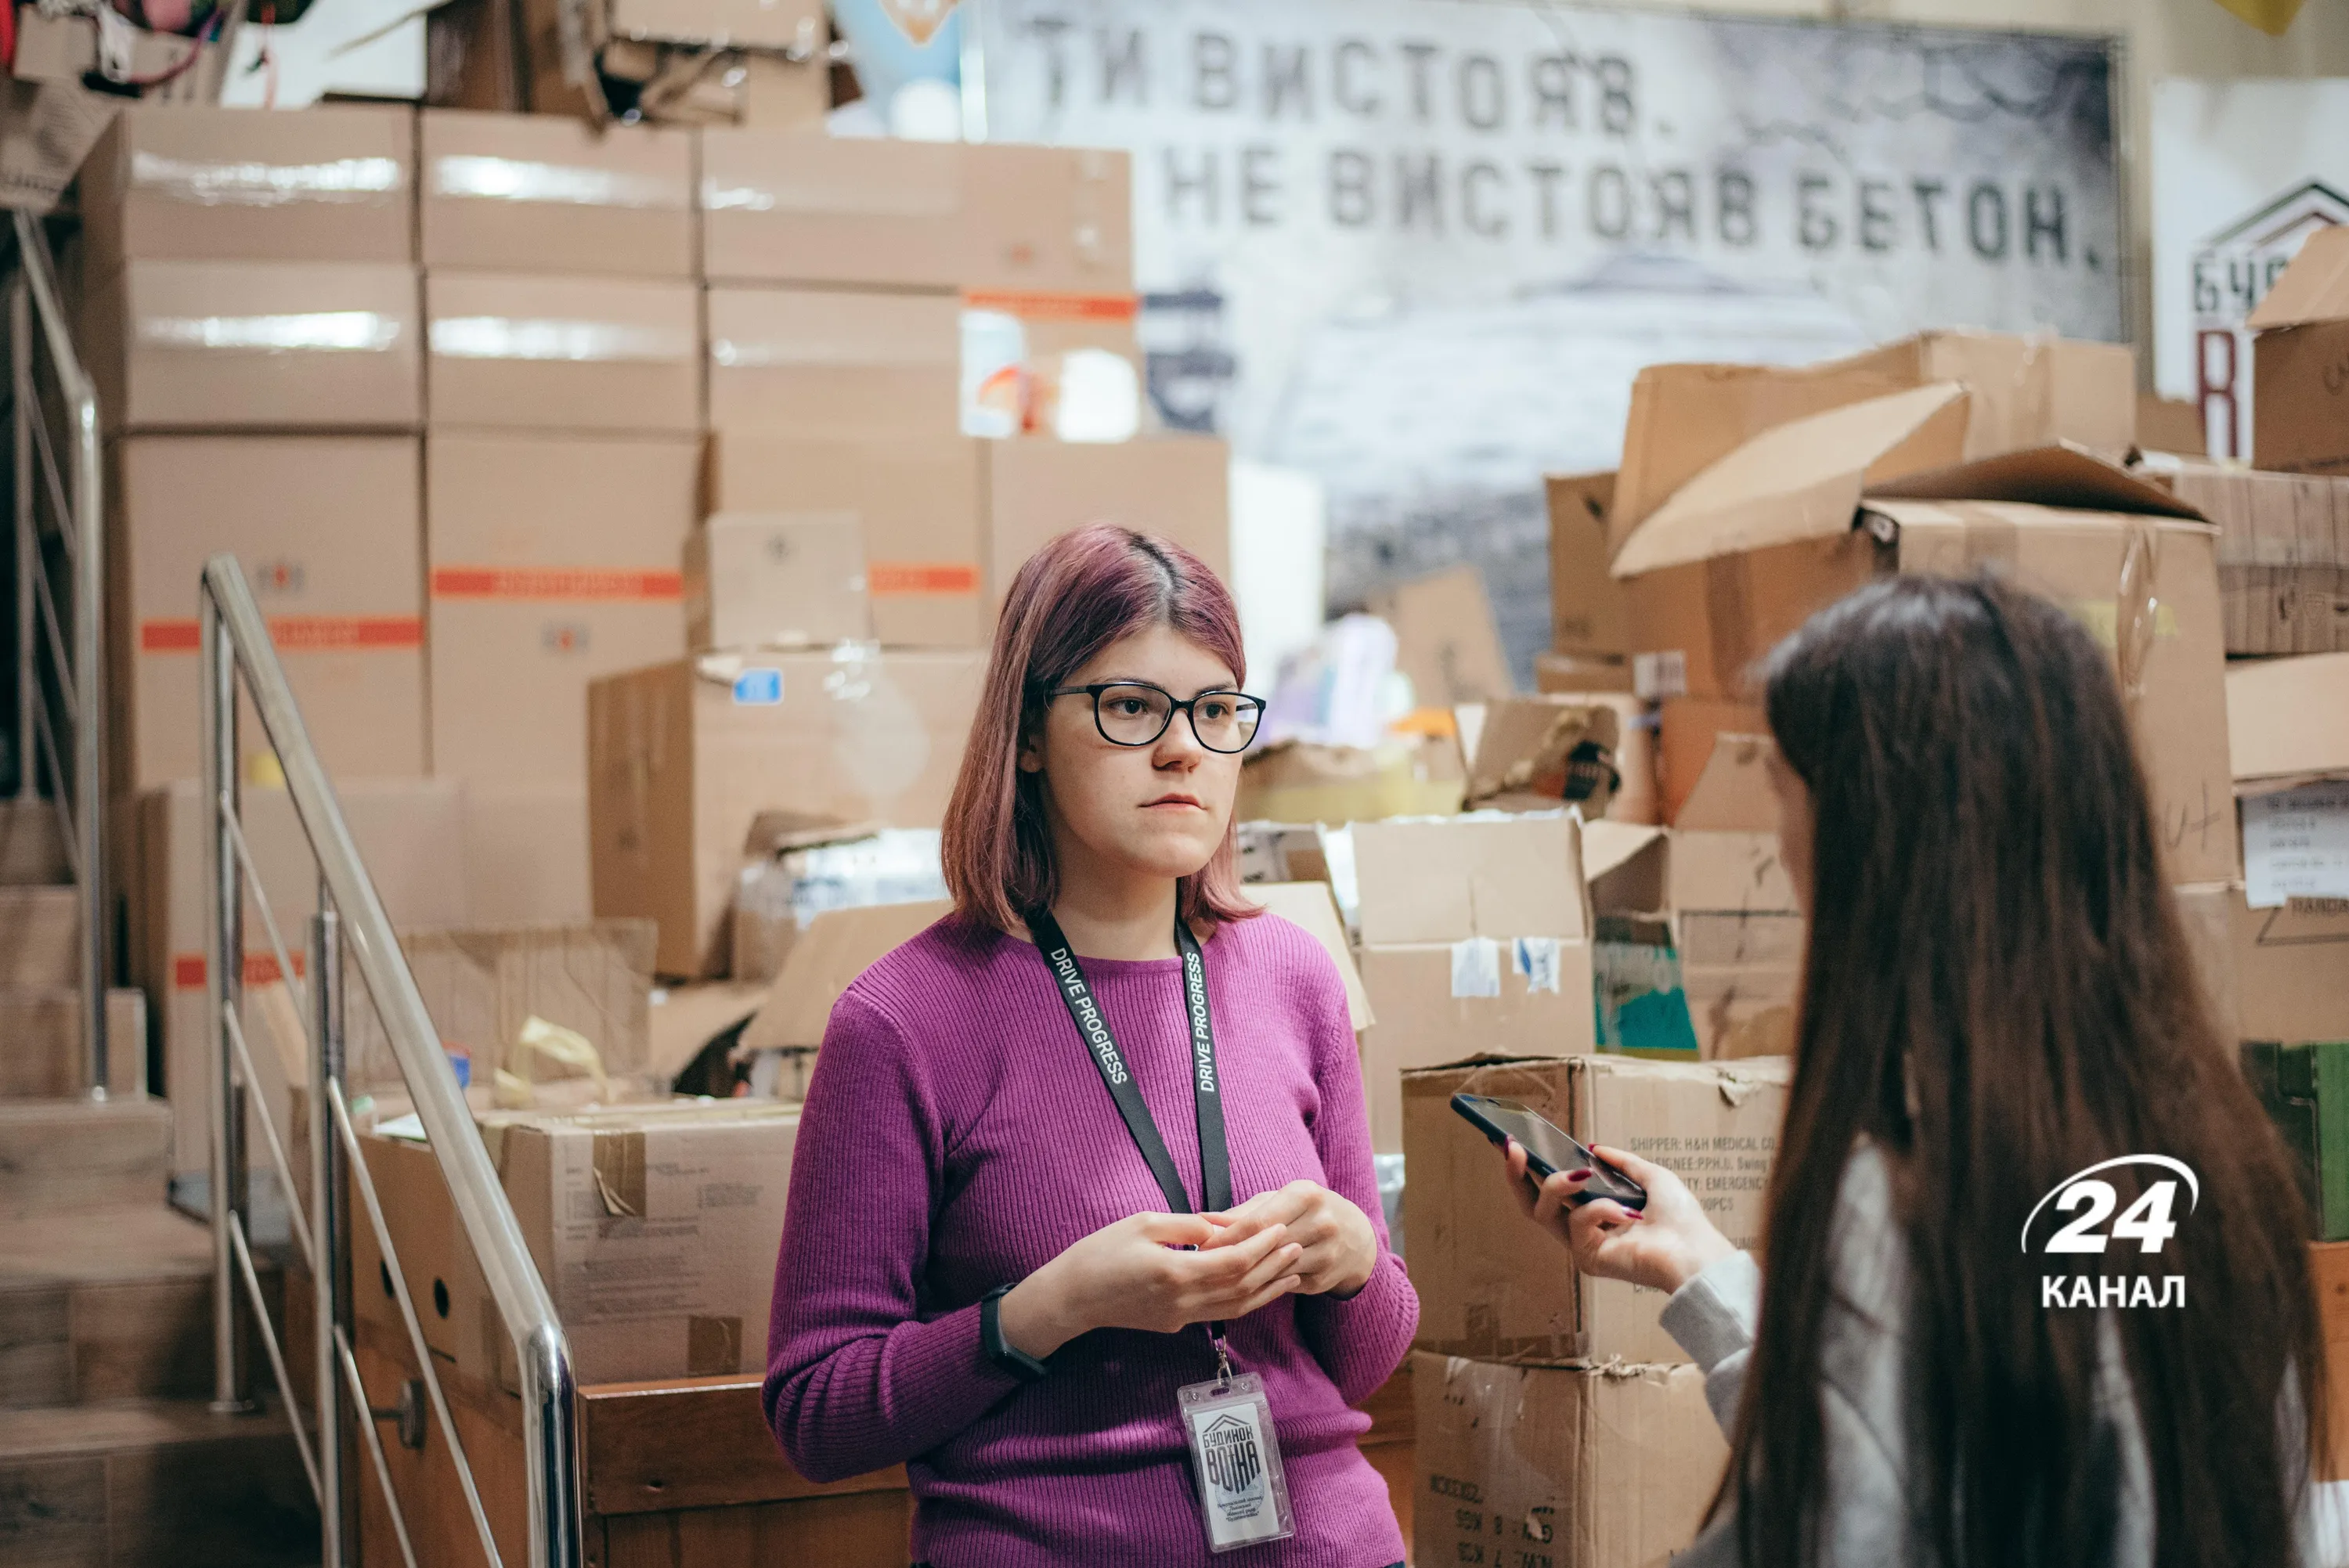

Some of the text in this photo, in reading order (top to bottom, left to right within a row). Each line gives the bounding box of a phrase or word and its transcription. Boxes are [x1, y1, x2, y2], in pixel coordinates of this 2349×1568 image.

[1020, 16, 1676, 136] ТИ ВИСТОЯВ.
[1164, 146, 2102, 271] НЕ ВИСТОЯВ БЕТОН.
[1051, 947, 1128, 1085] DRIVE PROGRESS
[1185, 951, 1215, 1093] DRIVE PROGRESS
[1630, 1137, 1682, 1152] SHIPPER:
[1685, 1137, 1709, 1152] H&H
[1712, 1137, 1759, 1152] MEDICAL
[1202, 1426, 1254, 1448] БУДИНОК
[1204, 1440, 1261, 1494] ВОЇНА
